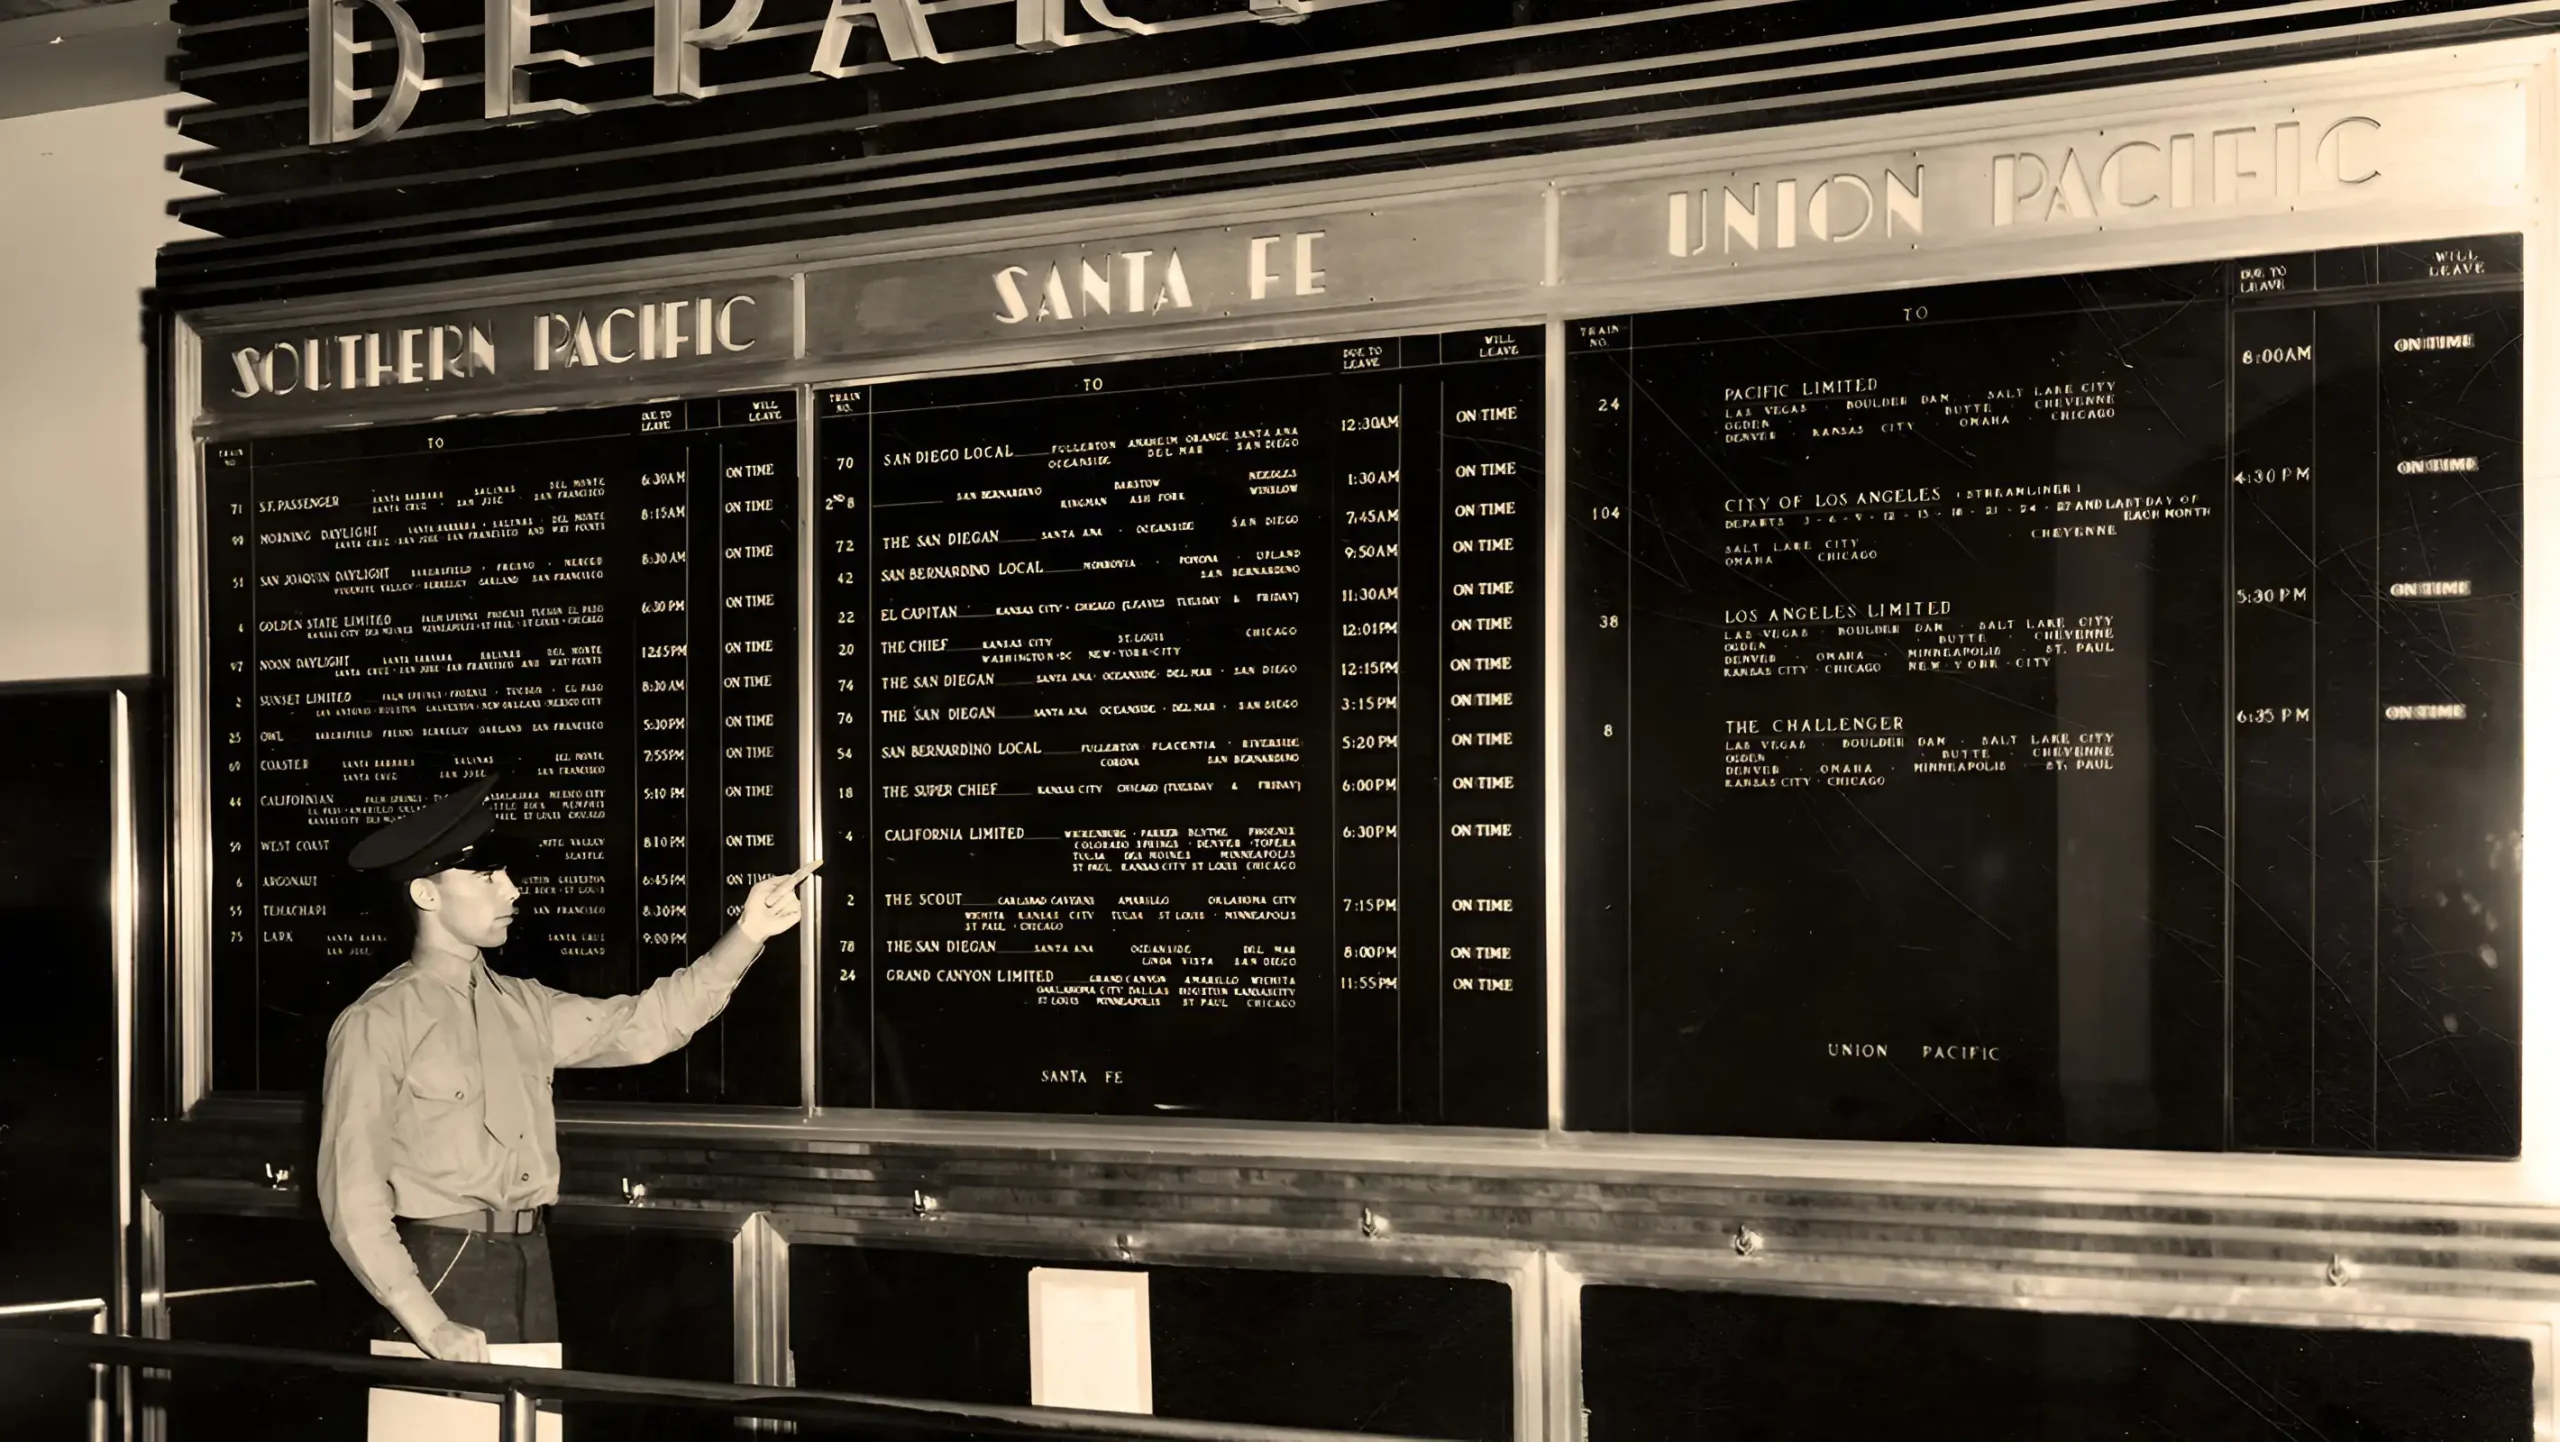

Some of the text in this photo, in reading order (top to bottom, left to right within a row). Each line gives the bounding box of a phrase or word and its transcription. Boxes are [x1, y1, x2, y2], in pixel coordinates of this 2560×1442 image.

[1668, 115, 2383, 257] UNION PACIFIC
[993, 230, 1328, 325] SANTA FE
[1903, 306, 1928, 322] TO
[232, 294, 757, 401] SOUTHERN PACIFIC
[1484, 334, 1515, 345] WILL
[1083, 377, 1104, 392] TO
[2080, 381, 2116, 393] CITY
[1598, 377, 1878, 412] 24 PACIFIC LIMITED
[1455, 405, 1518, 423] ON TIME
[427, 437, 445, 449] TO
[836, 444, 1014, 471] 70 SAN DIEGO LOCAL
[725, 463, 775, 479] ON TIME
[1455, 461, 1517, 478] ON TIME
[1592, 488, 1941, 521] 104 CITY OF LOS ANGELES
[835, 529, 1000, 553] 72 THE SAN DIEGAN
[1452, 537, 1515, 554] ON TIME
[837, 571, 854, 585] 42
[880, 568, 905, 583] SAN
[998, 560, 1044, 576] LOCAL
[2280, 587, 2307, 601] PM
[837, 605, 958, 624] 22 EL CAPITAN
[1599, 600, 1951, 629] 38 LOS ANGELES LIMITED
[838, 637, 949, 657] 20 THE CHIEF
[2076, 641, 2115, 653] PAUL
[837, 672, 995, 692] 74 THE SAN DIEGAN
[1450, 692, 1514, 707] ON TIME
[724, 713, 774, 728] ON TIME
[880, 708, 907, 723] THE
[913, 705, 940, 722] SAN
[948, 706, 996, 721] DIEGAN
[2281, 708, 2310, 723] PM
[2384, 705, 2418, 721] ON
[1603, 716, 1903, 738] 8 THE CHALLENGER
[836, 741, 1042, 760] 54 SAN BERNARDINO LOCAL
[1342, 735, 1375, 750] 5:20
[839, 786, 854, 800] 18
[882, 785, 909, 799] THE
[957, 782, 999, 797] CHIEF
[725, 833, 775, 848] ON TIME
[884, 827, 963, 842] CALIFORNIA
[969, 826, 1025, 841] LIMITED
[846, 892, 963, 907] 2 THE SCOUT
[1451, 898, 1514, 913] ON TIME
[886, 939, 913, 954] THE
[914, 940, 940, 953] SAN
[946, 939, 997, 954] DIEGAN
[839, 968, 1054, 983] 24 GRAND CANYON LIMITED
[1452, 977, 1514, 992] ON TIME
[1828, 1043, 2000, 1061] UNION PACIFIC
[1040, 1069, 1123, 1084] SANTA FE
